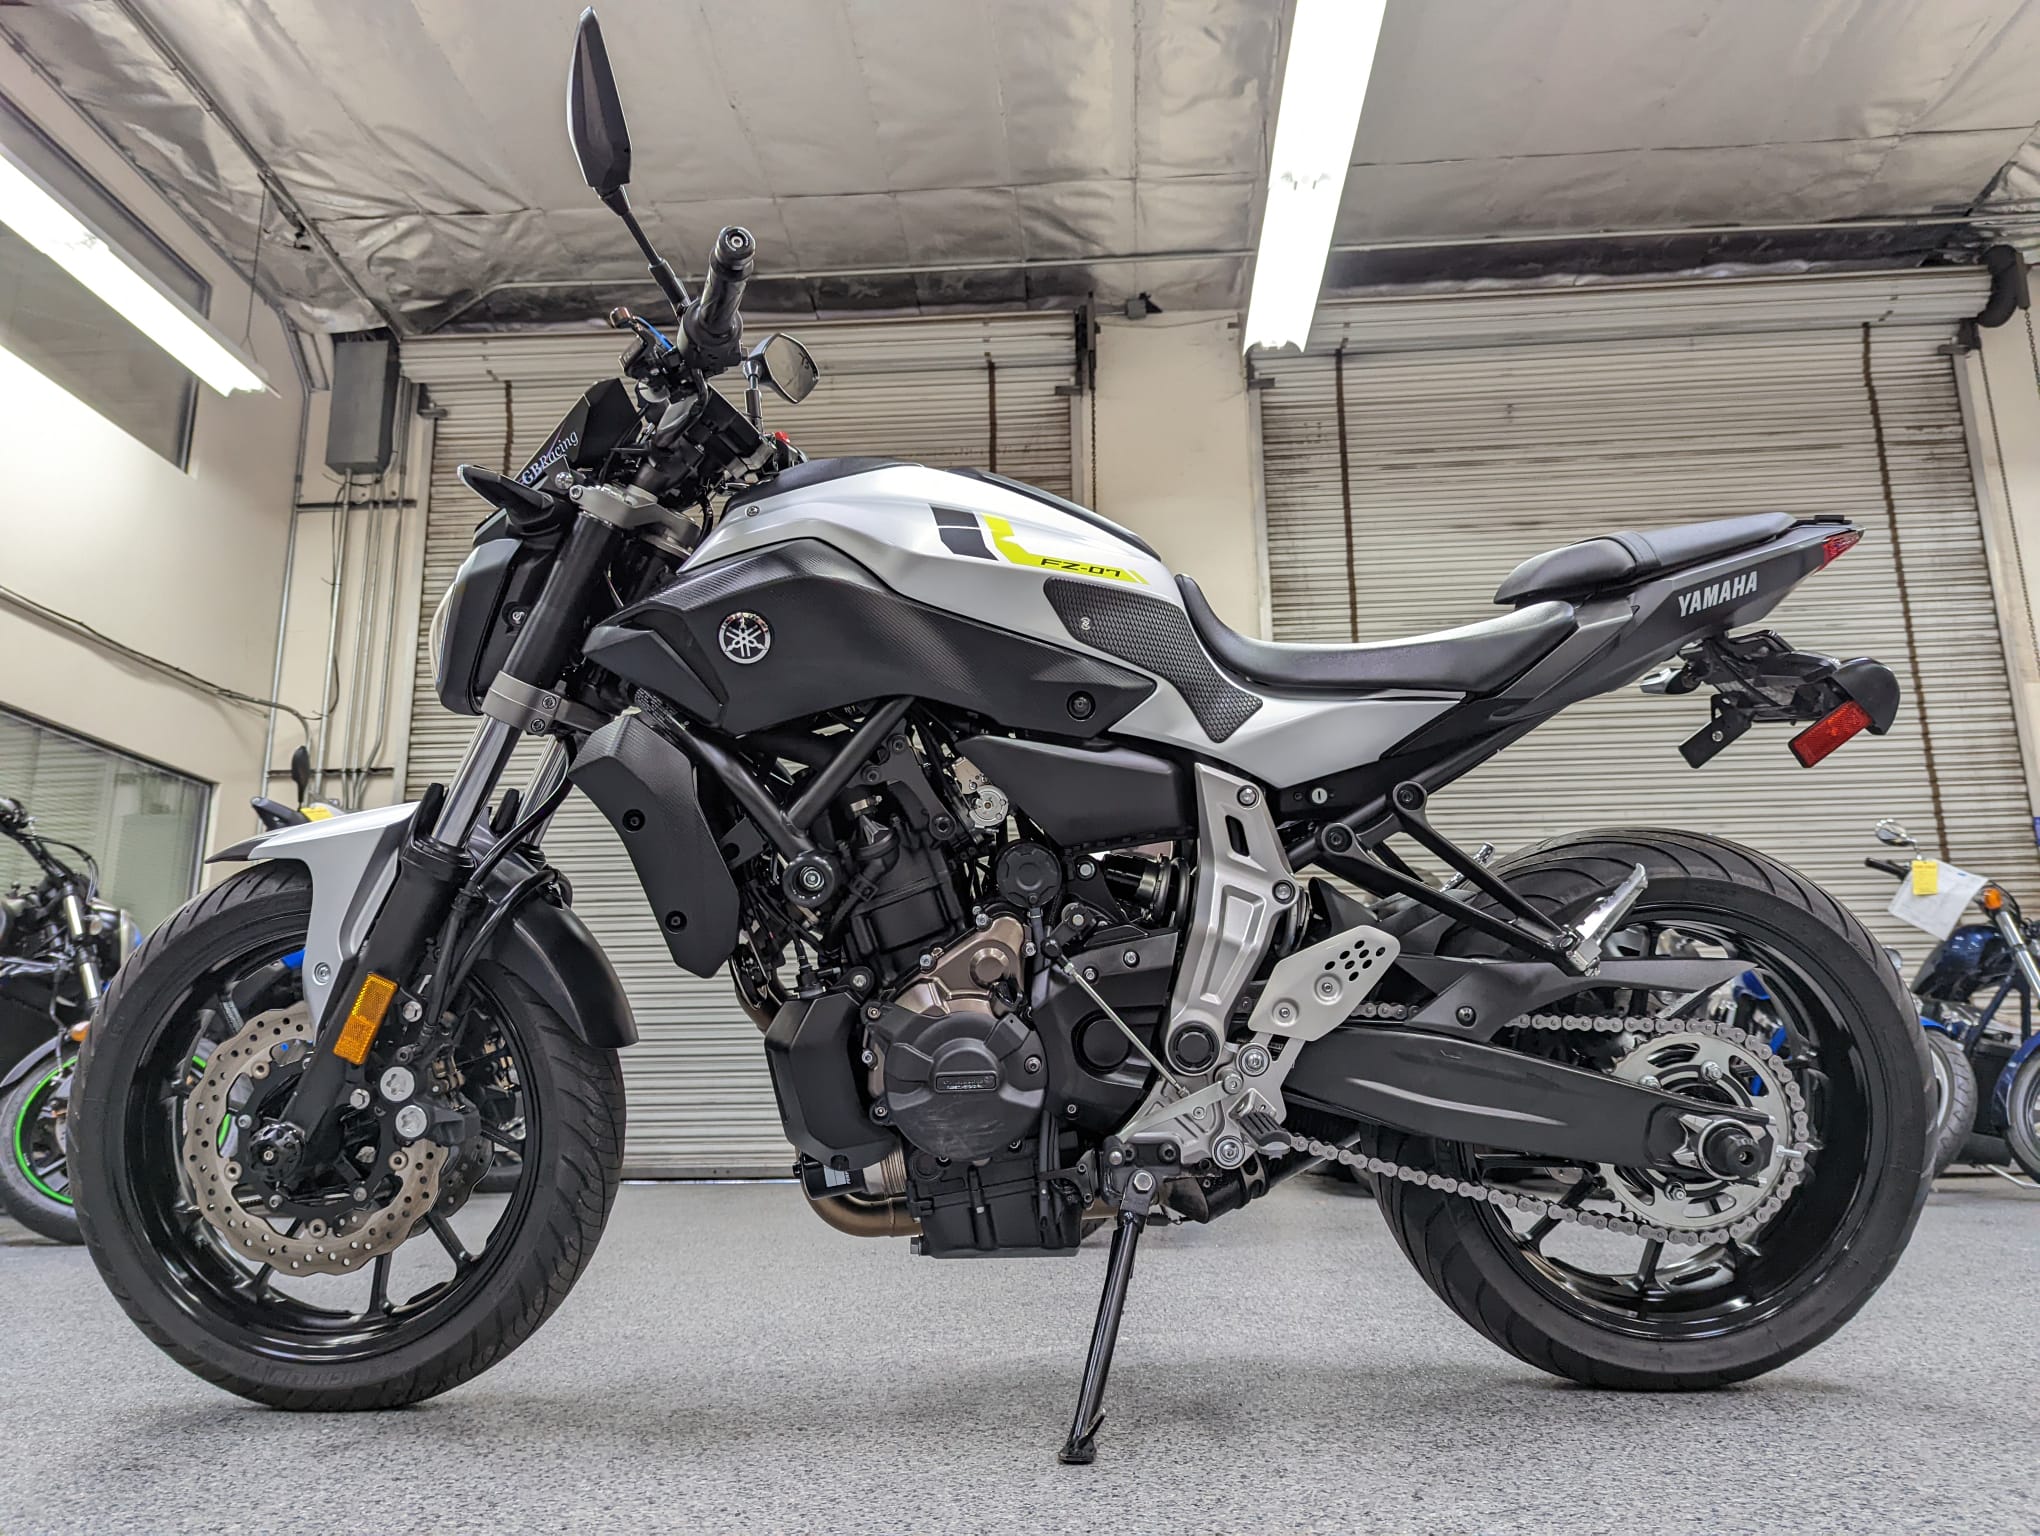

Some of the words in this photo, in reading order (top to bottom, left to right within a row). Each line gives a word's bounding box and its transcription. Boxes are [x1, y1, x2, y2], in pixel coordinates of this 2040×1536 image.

[522, 431, 579, 485] GBRacing
[1041, 558, 1121, 577] FZ-07
[1678, 571, 1757, 617] YAMAHA
